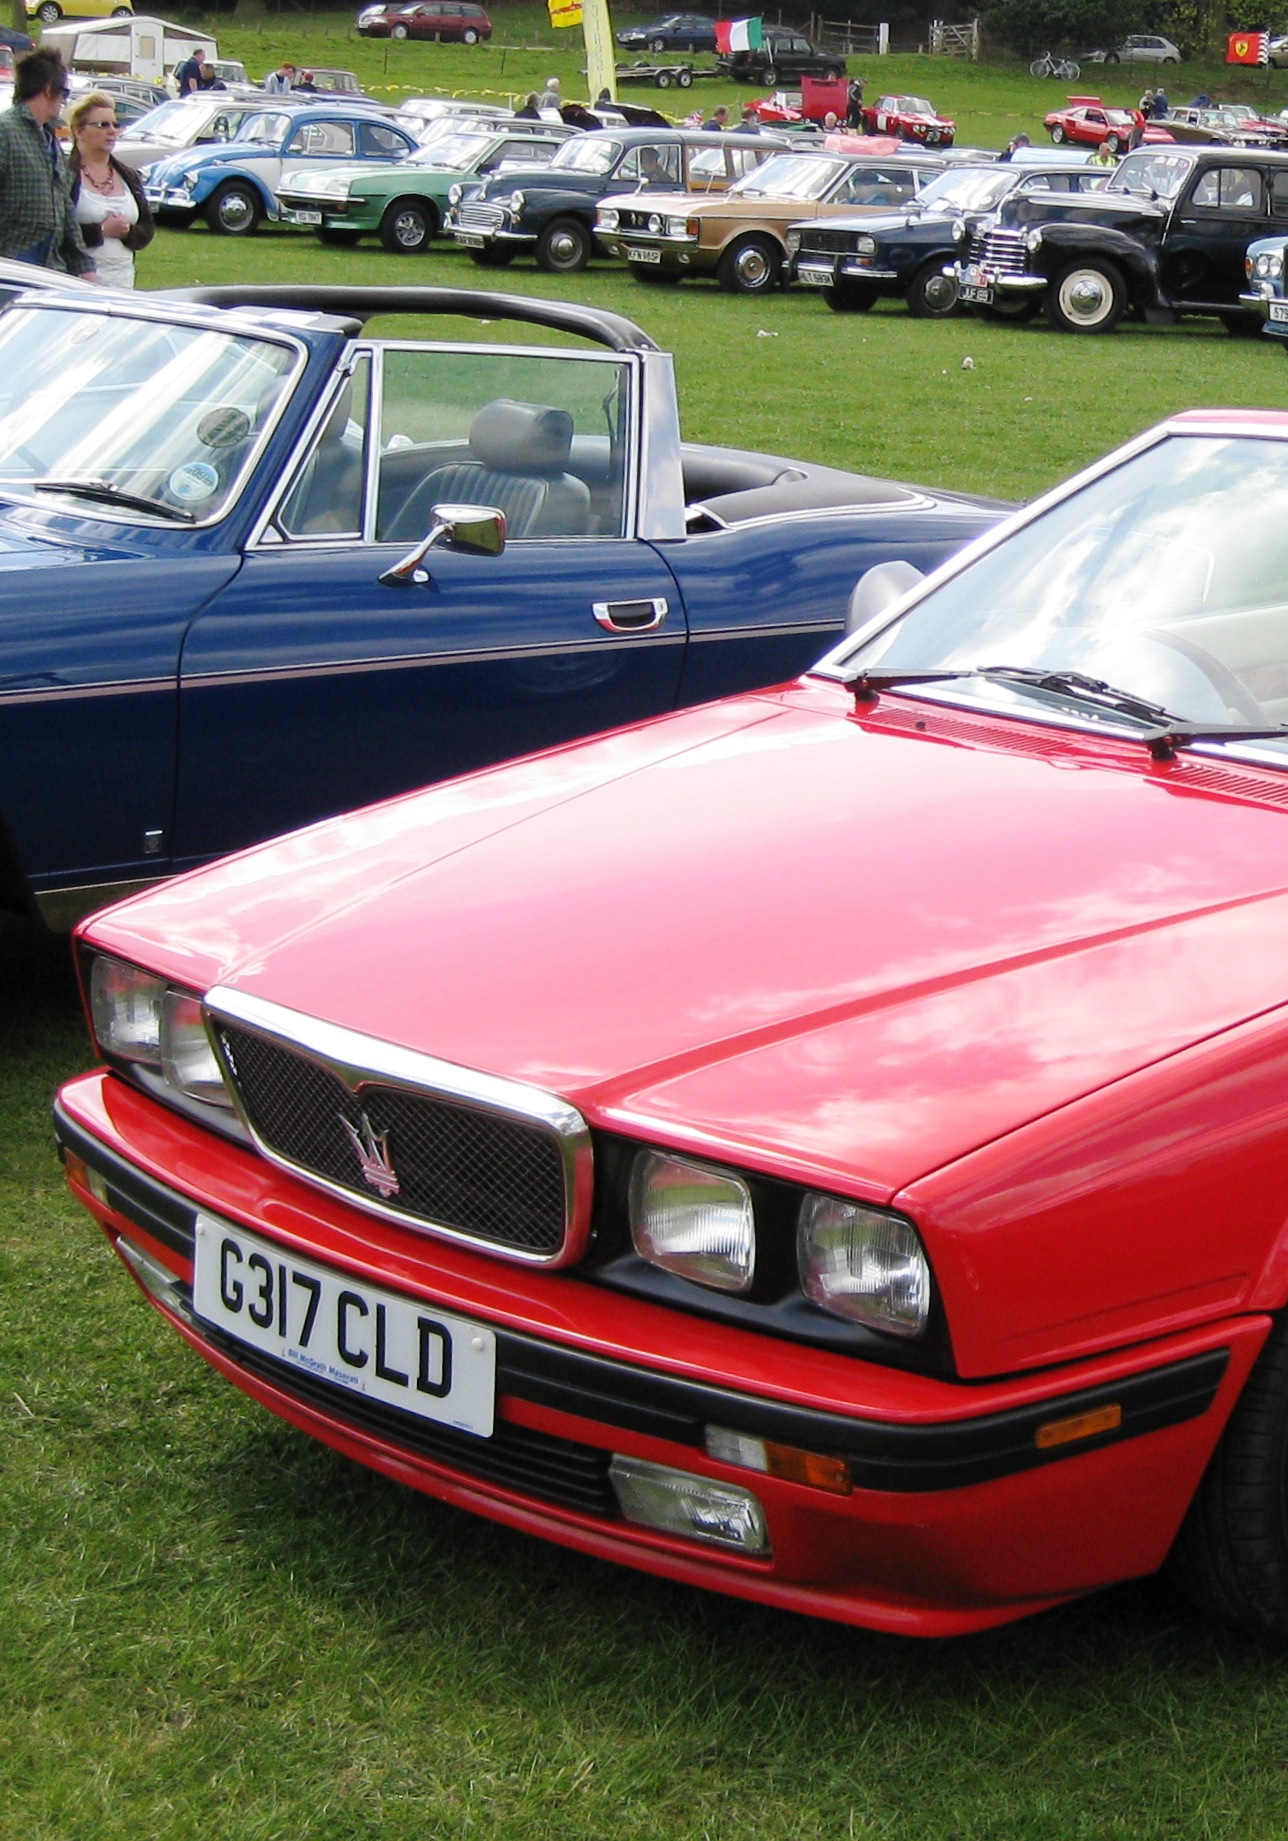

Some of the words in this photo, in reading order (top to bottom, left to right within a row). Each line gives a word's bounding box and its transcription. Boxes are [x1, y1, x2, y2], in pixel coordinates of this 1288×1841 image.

[1274, 307, 1288, 320] 579
[220, 1237, 322, 1348] G317
[337, 1290, 453, 1399] CLD
